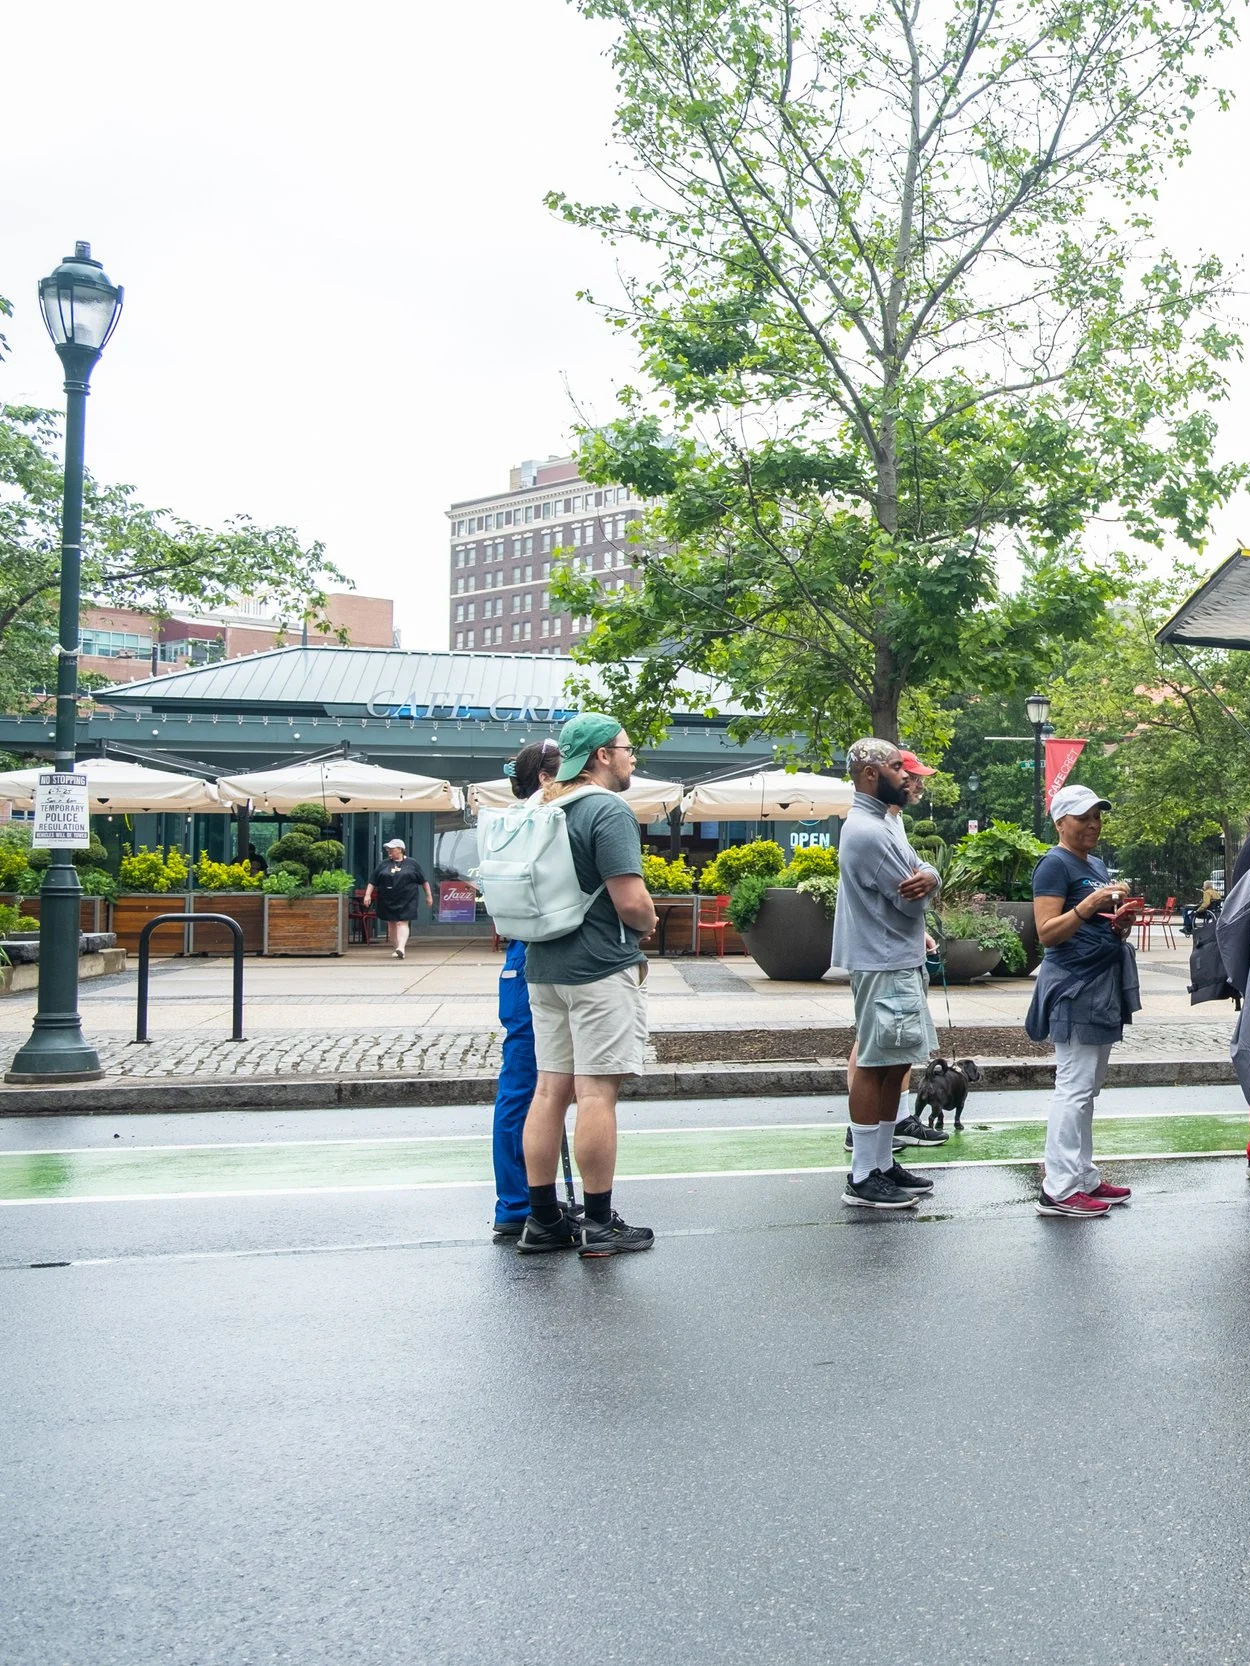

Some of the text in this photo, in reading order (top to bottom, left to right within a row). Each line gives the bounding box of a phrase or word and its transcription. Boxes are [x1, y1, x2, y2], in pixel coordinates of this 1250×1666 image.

[366, 690, 475, 721] CAFE
[40, 775, 86, 785] NO STOPPING
[41, 804, 85, 812] TEMPORARY
[45, 813, 78, 822] POLICE
[38, 823, 85, 831] REGULATION
[790, 832, 830, 849] OPEN
[443, 887, 473, 901] Jazz
